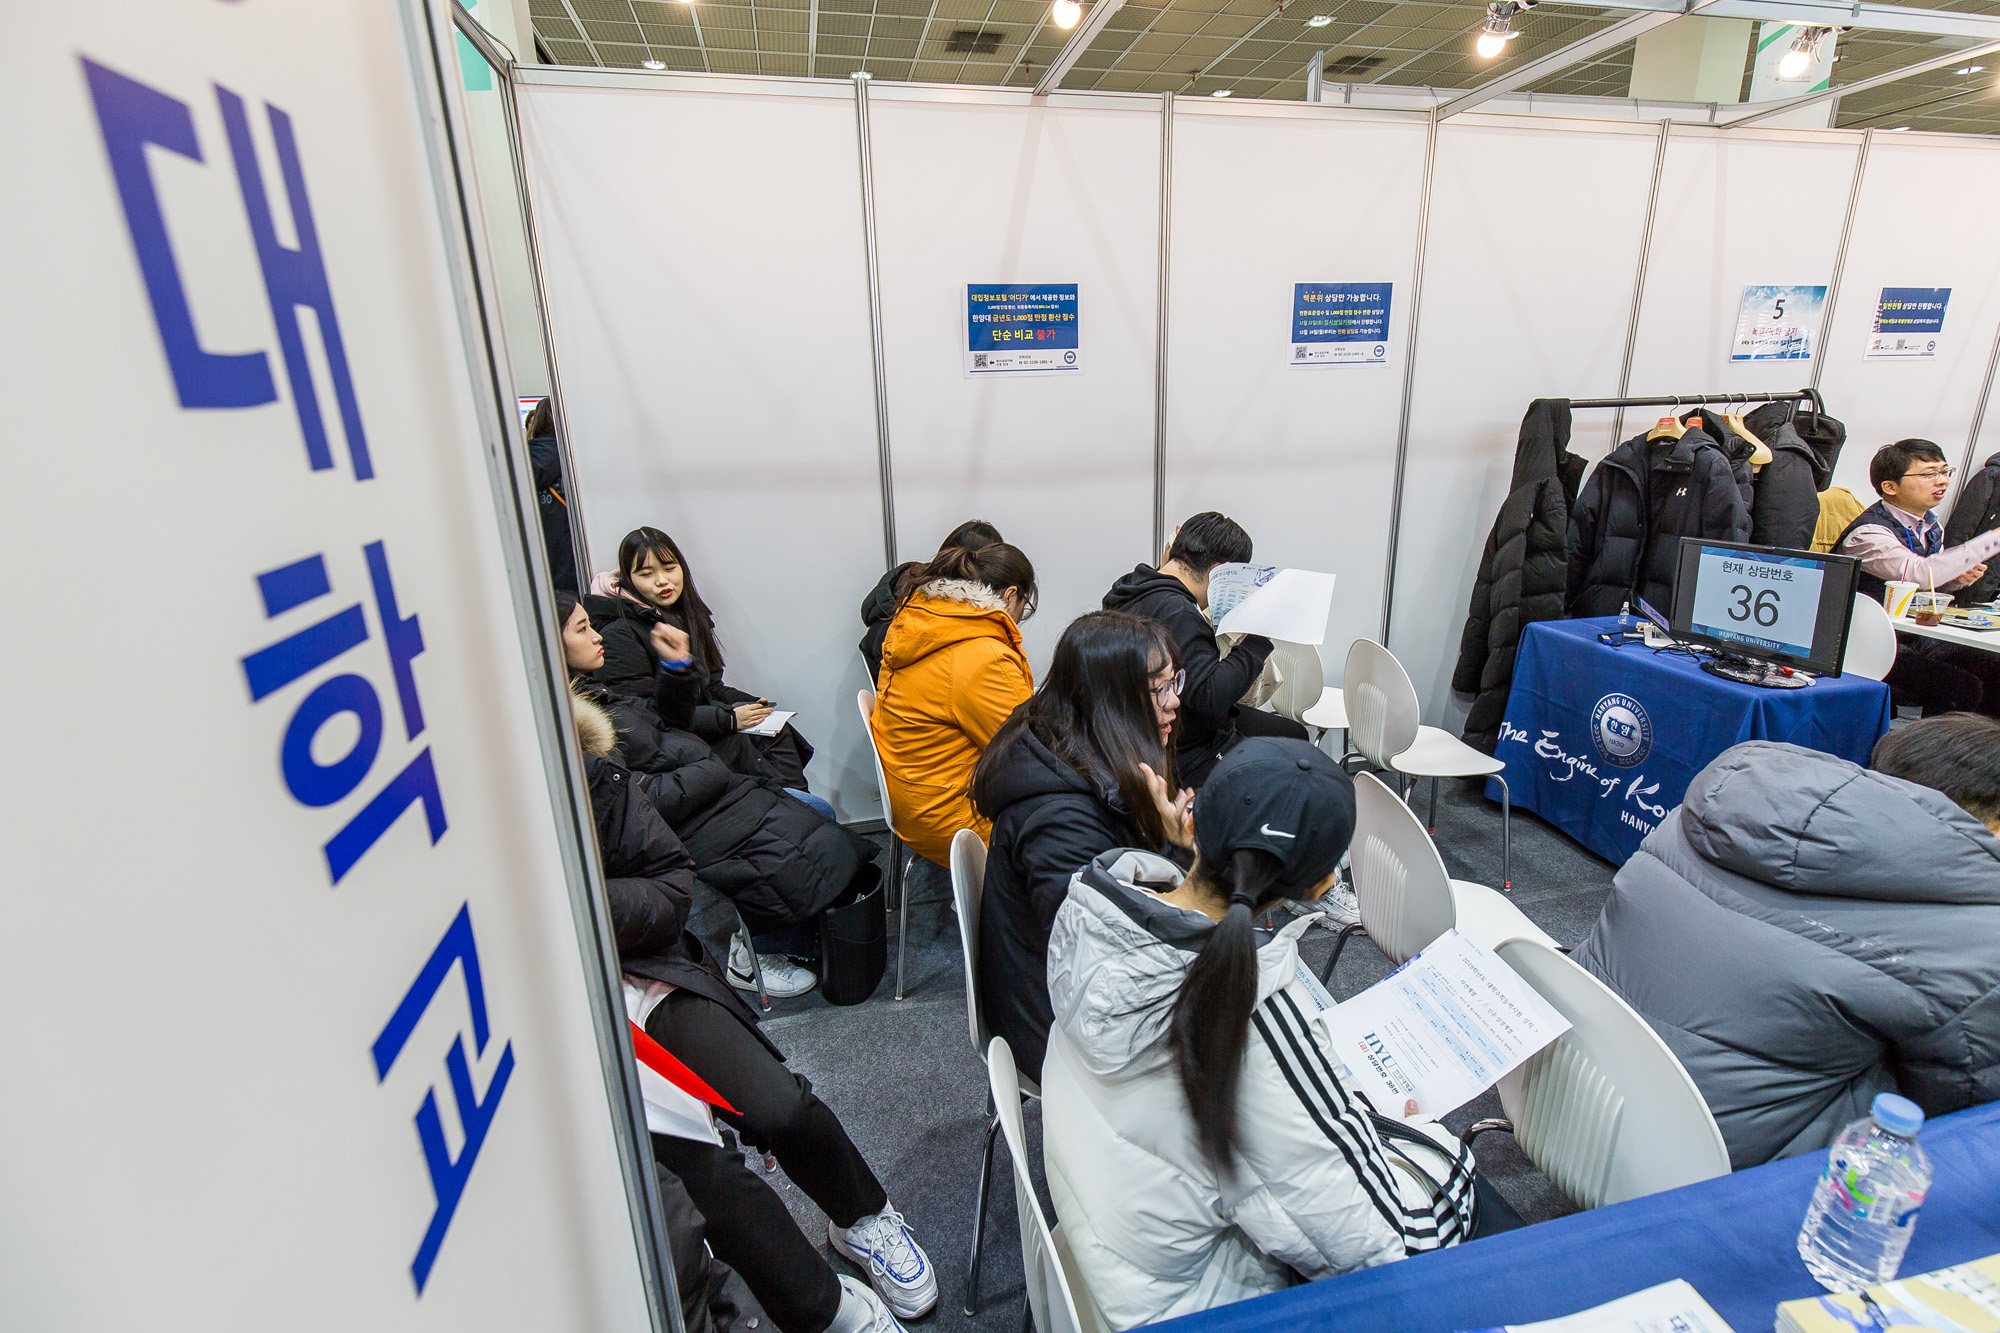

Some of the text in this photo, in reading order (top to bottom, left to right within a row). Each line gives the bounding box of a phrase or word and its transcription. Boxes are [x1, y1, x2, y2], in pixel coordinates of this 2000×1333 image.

[1303, 294, 1382, 302] 백분위 상담만 가능합니다.
[972, 314, 991, 322] 한양대
[993, 314, 1011, 322] 금년도
[1063, 313, 1075, 321] 점수
[1773, 299, 1785, 320] 5
[993, 329, 1055, 341] 단순 비교 불가
[1722, 561, 1793, 582] 현재 상담번호
[1727, 585, 1781, 626] 36
[1718, 631, 1781, 650] HANYANG UNIVERSITY
[1594, 697, 1651, 742] HANYANG UNIVERSITY
[1609, 720, 1632, 736] 한양
[1608, 738, 1624, 748] 1939
[1498, 721, 1671, 818] The Engine of Ko
[1362, 1031, 1398, 1070] HYU
[1367, 1054, 1388, 1079] 상담번호
[1386, 1080, 1400, 1095] 38번
